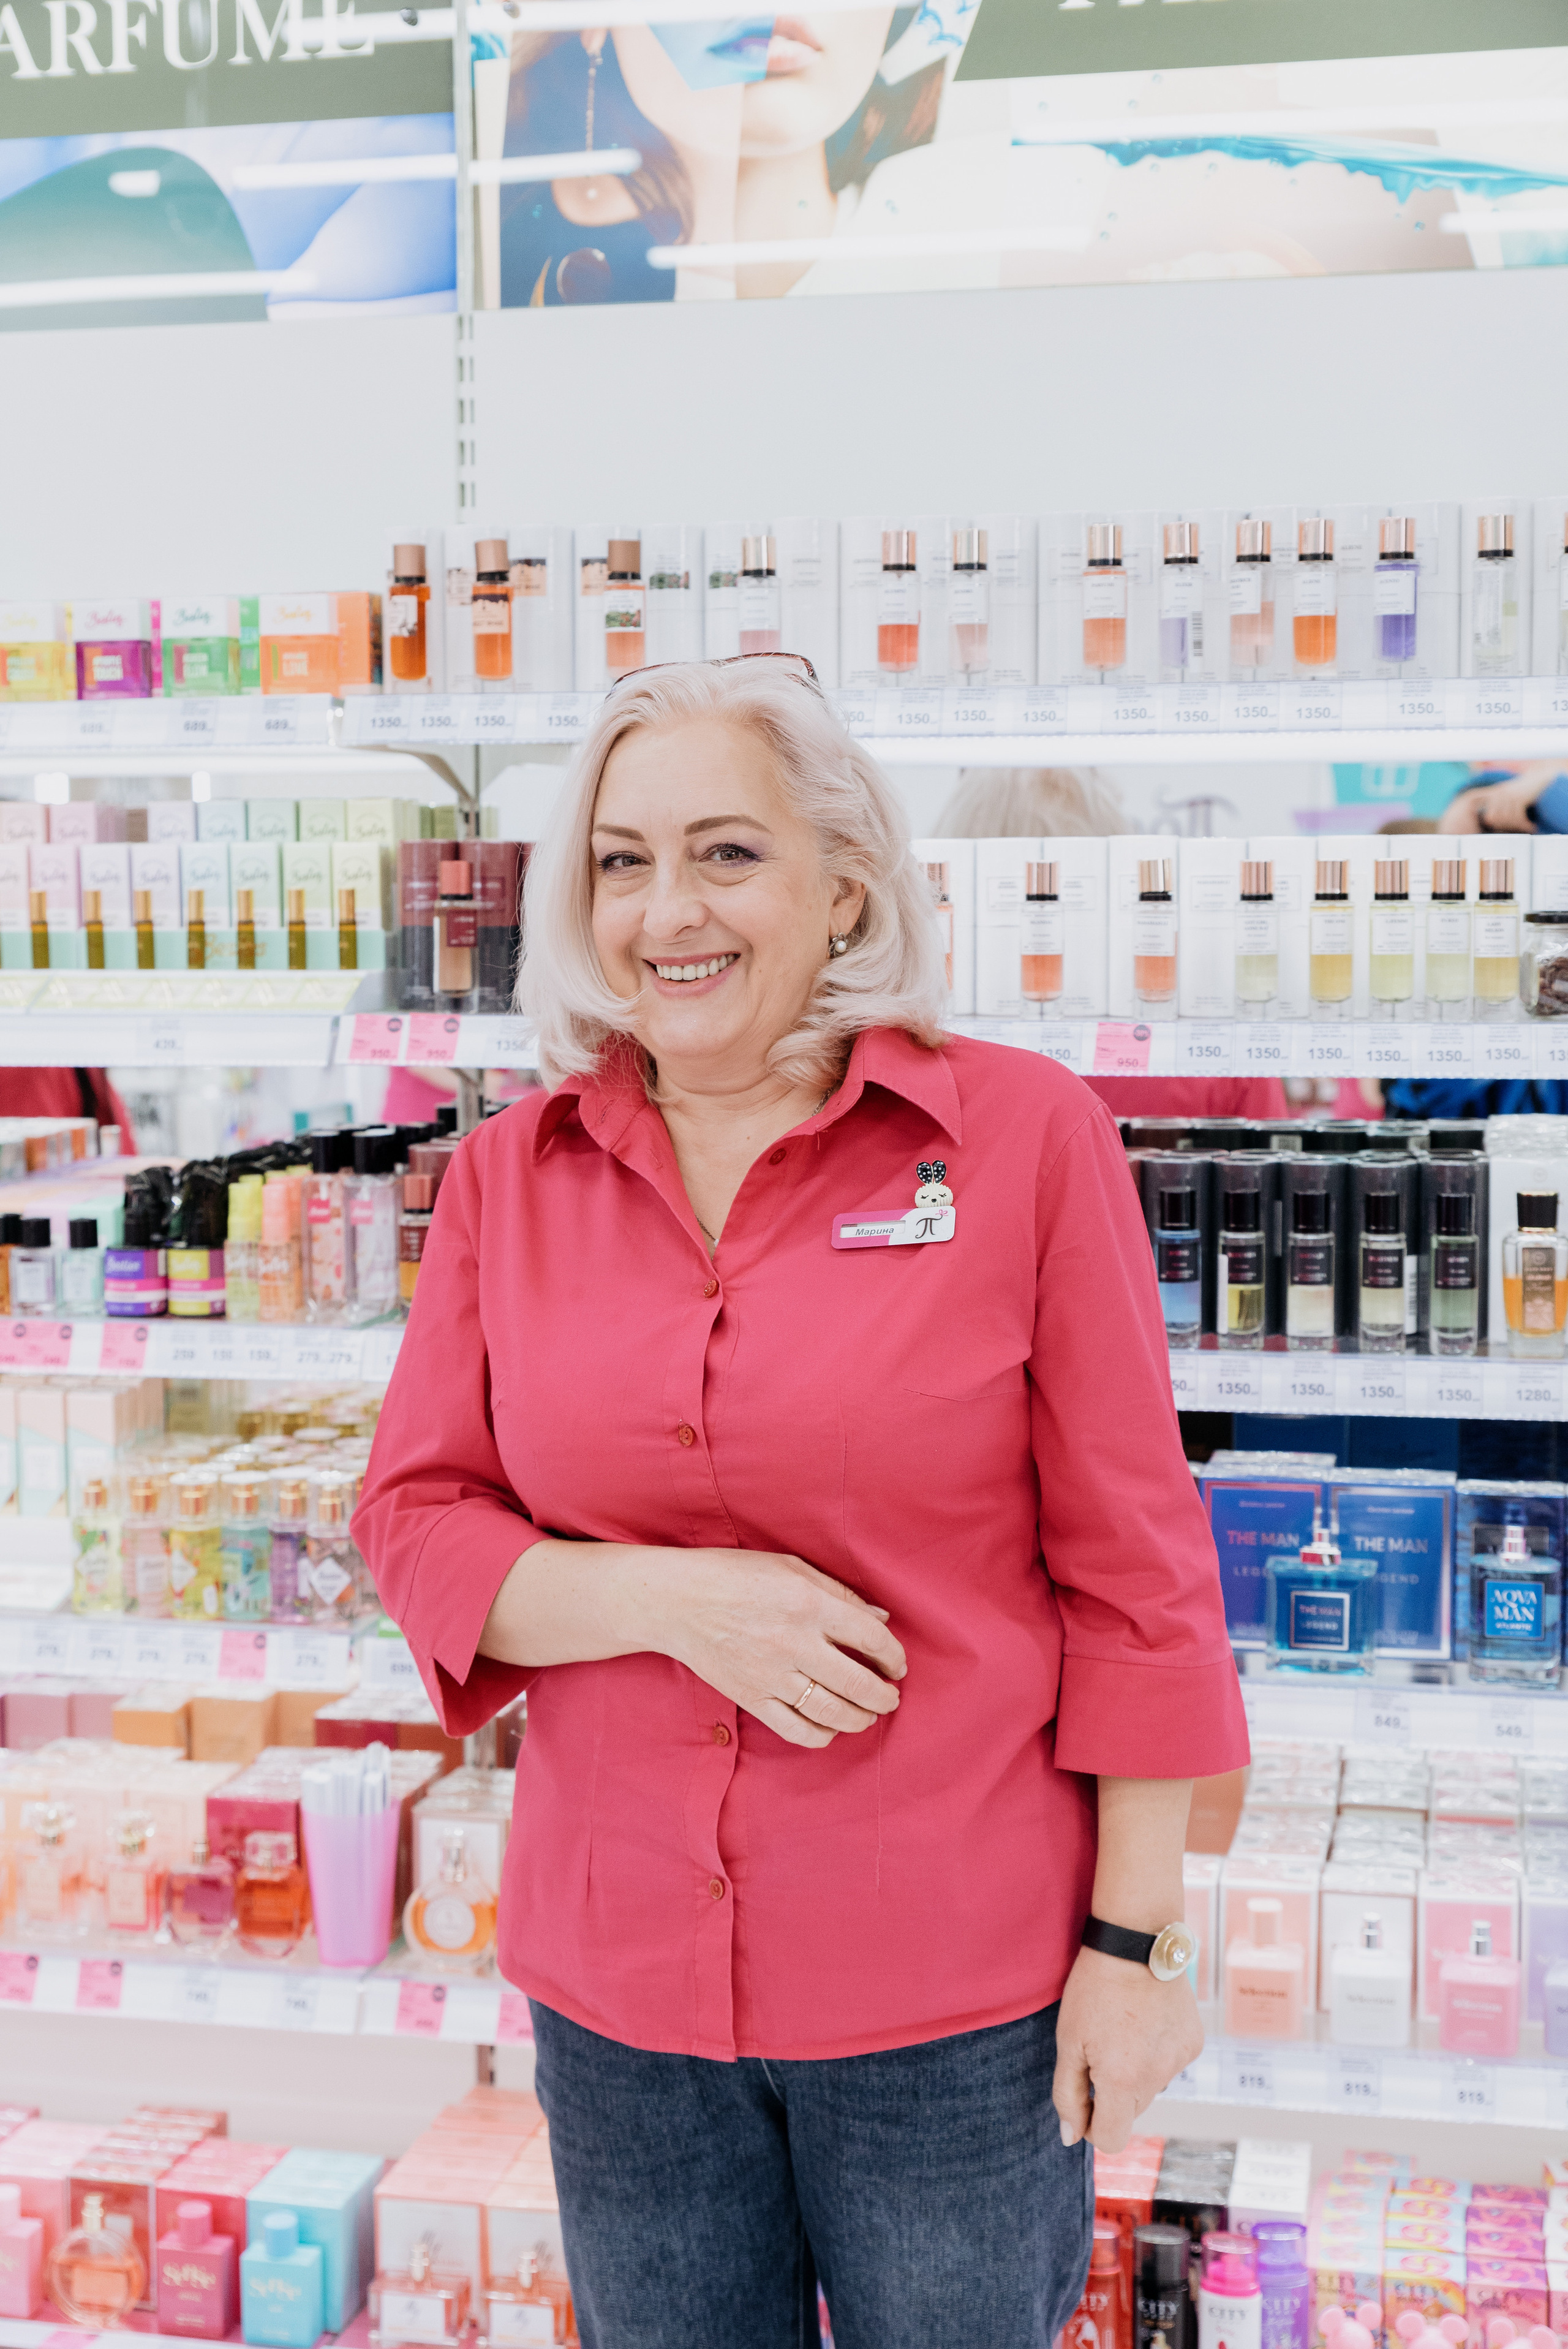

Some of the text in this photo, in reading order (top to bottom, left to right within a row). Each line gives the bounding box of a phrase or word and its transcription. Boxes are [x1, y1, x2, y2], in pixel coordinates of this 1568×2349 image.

[1114, 708, 1147, 719] 1350
[1235, 706, 1268, 717] 1350
[1297, 707, 1330, 719] 1350
[1400, 703, 1434, 714] 1350
[1476, 703, 1510, 714] 1350
[475, 716, 505, 726] 1350
[898, 713, 930, 724] 1350
[954, 710, 986, 721] 1350
[1023, 711, 1056, 722] 1350
[1175, 711, 1209, 722] 1350
[372, 717, 401, 728] 1350
[421, 716, 451, 727] 1350
[548, 716, 578, 727] 1350
[1188, 1046, 1221, 1057] 1350
[1247, 1048, 1280, 1059] 1350
[1309, 1048, 1342, 1059] 1350
[1367, 1050, 1403, 1061] 1350
[1428, 1051, 1462, 1062] 1350
[1486, 1048, 1520, 1060] 1350
[1117, 1057, 1137, 1067] 950
[855, 1227, 894, 1236] Марина
[1218, 1383, 1250, 1394] 1350
[1292, 1383, 1324, 1396] 1350
[1361, 1386, 1394, 1398] 1350
[1438, 1390, 1472, 1401] 1350
[1517, 1390, 1551, 1401] 1280
[1227, 1532, 1299, 1547] THE MAN
[1354, 1535, 1428, 1554] THE MAN
[1493, 1606, 1534, 1621] MAN
